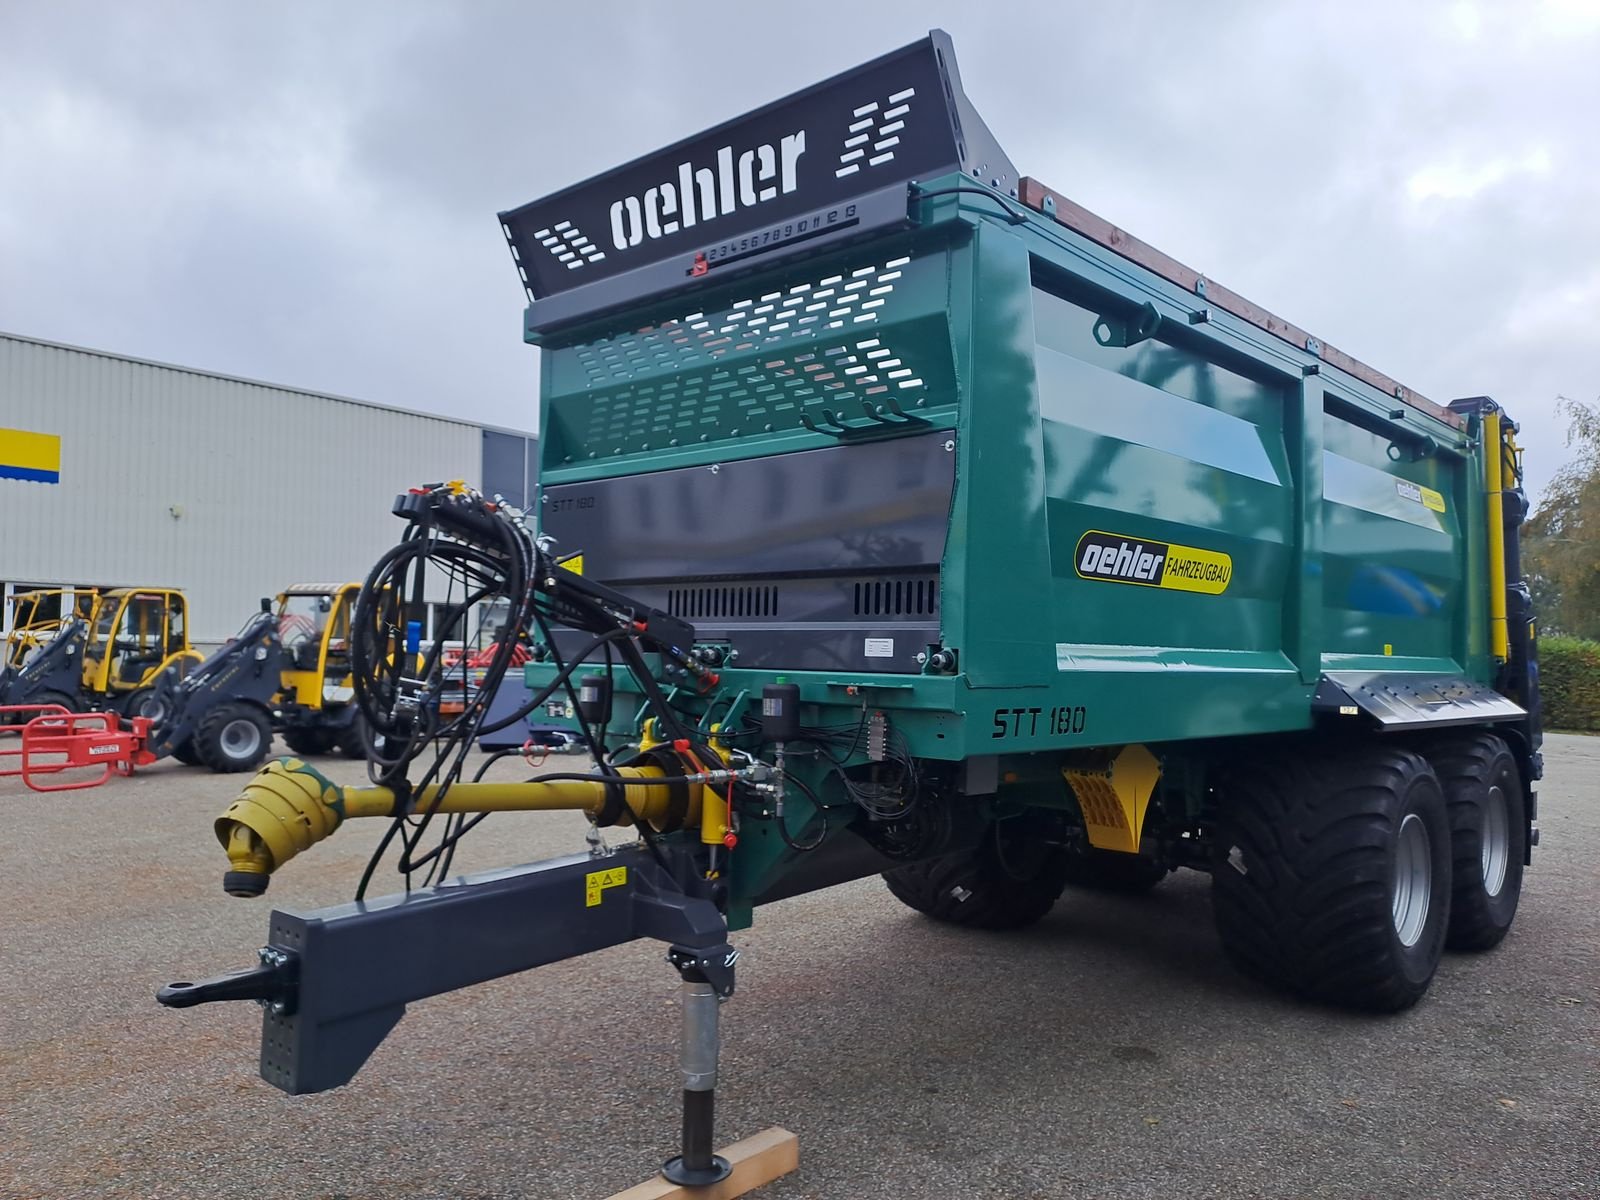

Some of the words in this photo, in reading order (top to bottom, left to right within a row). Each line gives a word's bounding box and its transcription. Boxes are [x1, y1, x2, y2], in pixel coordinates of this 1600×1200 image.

[609, 129, 806, 250] oehler
[709, 249, 717, 260] 2
[720, 246, 727, 257] 3
[741, 239, 748, 251] 5
[751, 236, 759, 248] 6
[763, 232, 770, 244] 7
[773, 229, 780, 241] 8
[785, 225, 793, 238] 9
[797, 220, 808, 233] 10
[812, 216, 820, 229] 11
[827, 210, 838, 224] 12
[846, 204, 857, 217] 13
[552, 499, 574, 513] STT
[577, 496, 595, 509] 180
[1080, 542, 1165, 580] oehler
[1164, 557, 1230, 583] FAHRZEUGBAU
[992, 707, 1043, 739] STT
[1050, 706, 1087, 735] 180
